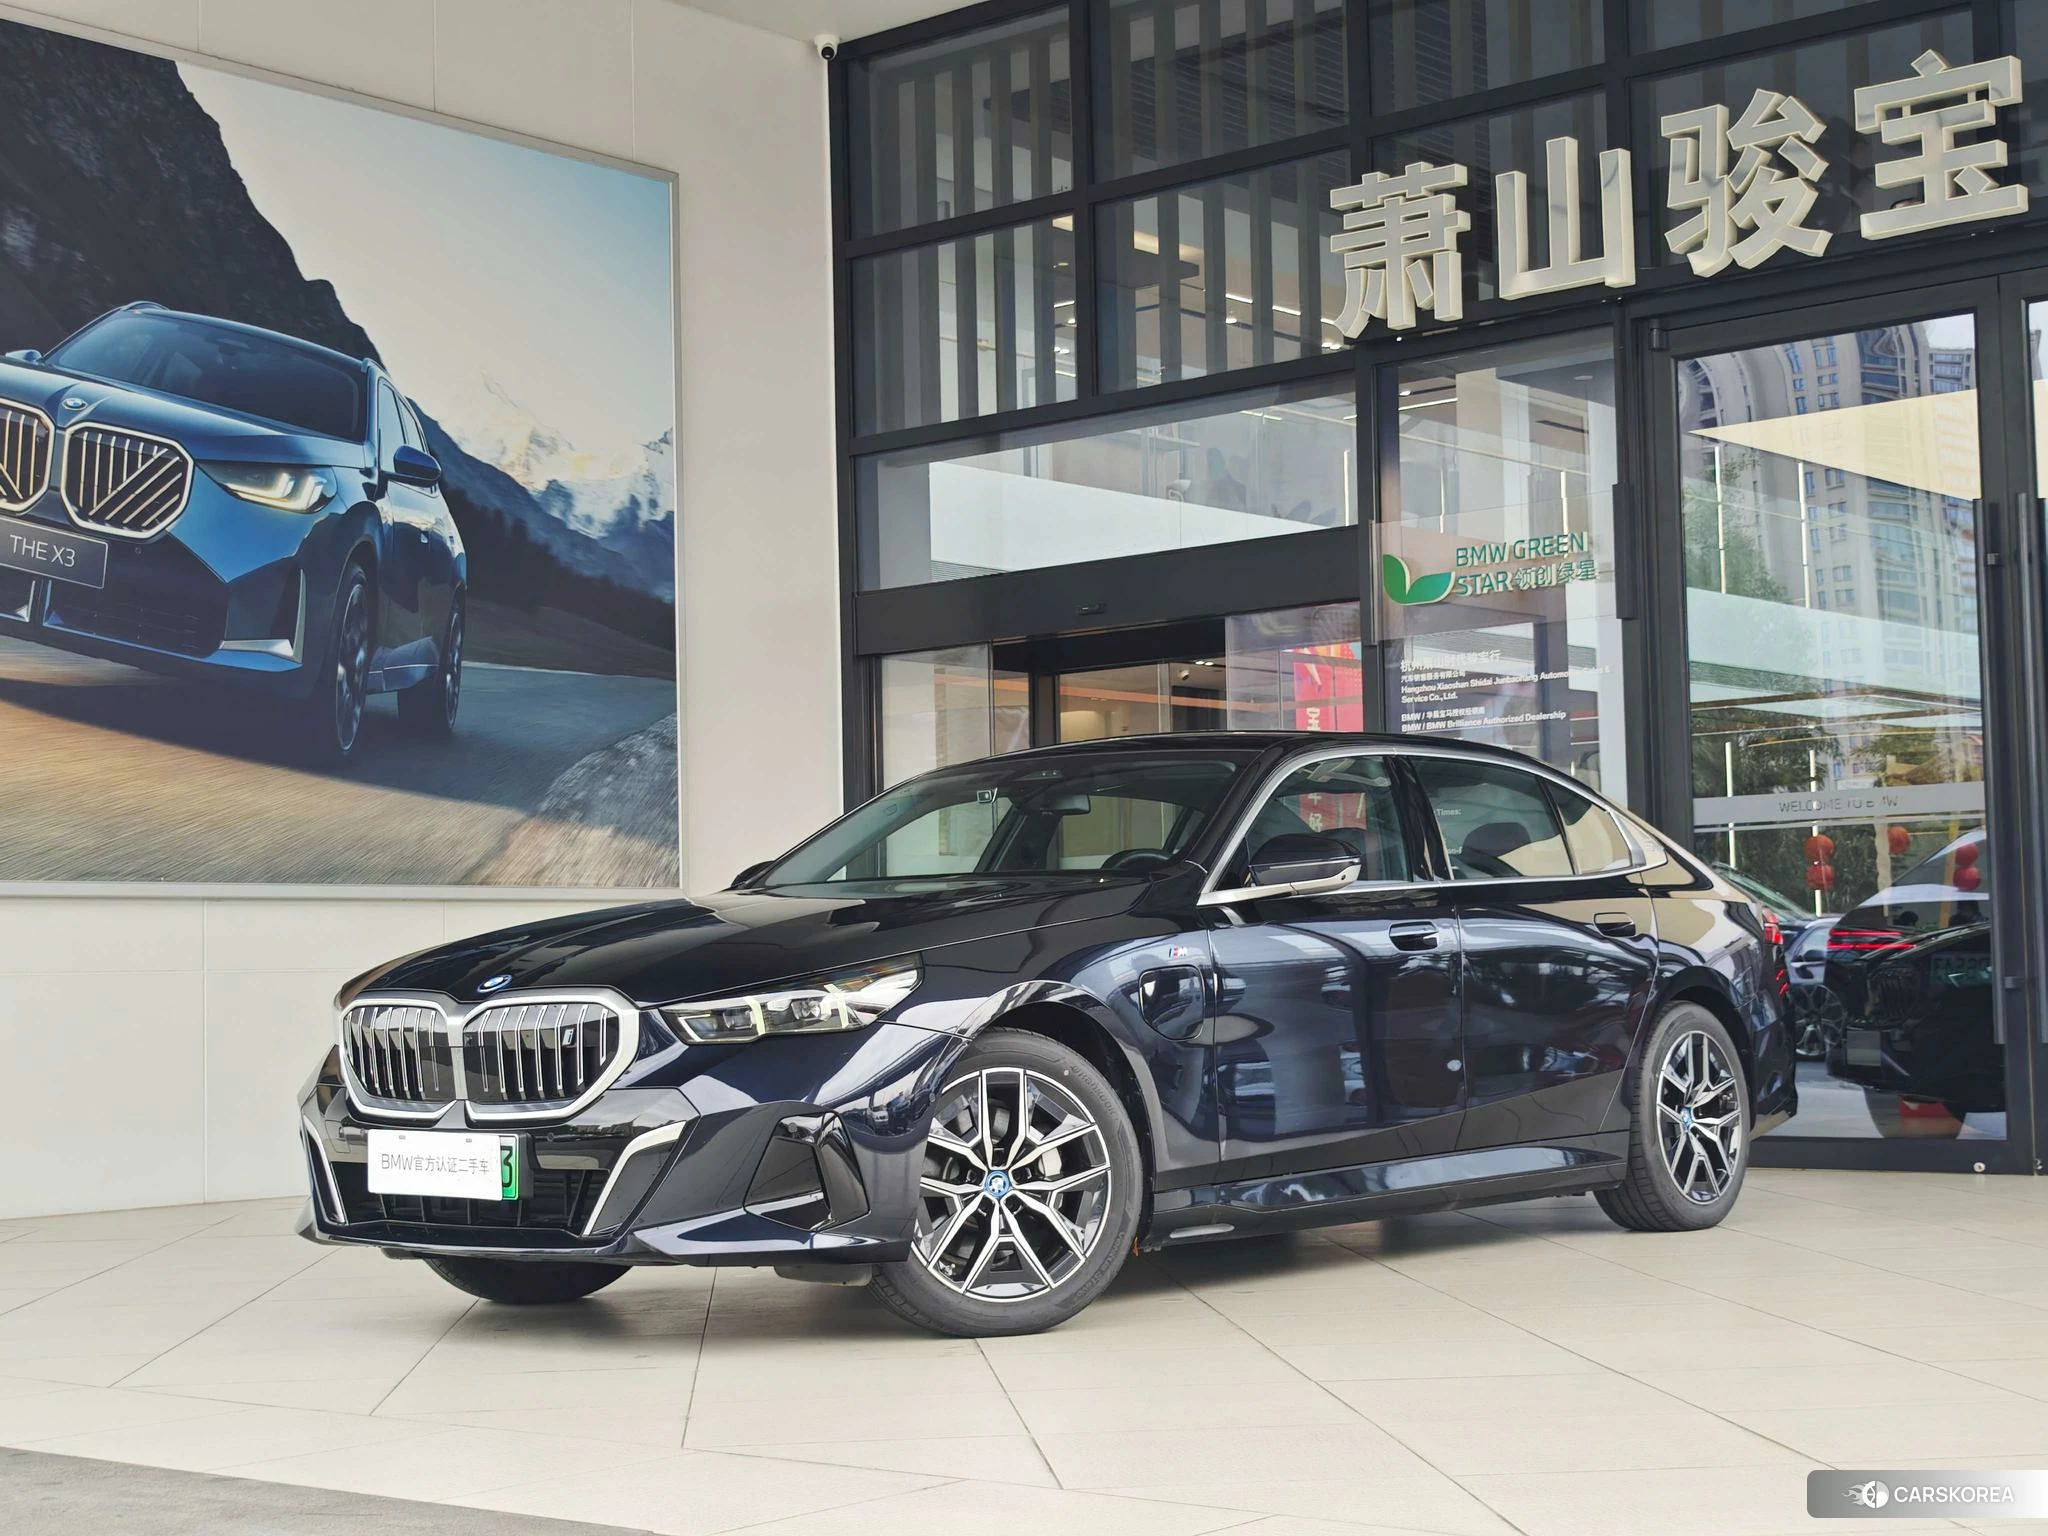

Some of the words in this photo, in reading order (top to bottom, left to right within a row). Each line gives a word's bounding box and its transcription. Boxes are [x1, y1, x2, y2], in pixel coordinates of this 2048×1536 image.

[1330, 49, 2029, 339] 萧山骏宝
[9, 534, 48, 561] THE
[51, 544, 76, 568] X3
[1456, 542, 1508, 567] BMW
[1513, 532, 1585, 560] GREEN
[1456, 571, 1510, 597] STAR
[1515, 560, 1597, 590] 领创绿星
[1401, 683, 1436, 694] Hangzhou
[1437, 680, 1469, 690] Xiaoshan
[1401, 694, 1428, 703] Service
[1401, 712, 1421, 721] BMW
[1401, 722, 1421, 733] BMW
[1426, 720, 1446, 730] BMW
[1447, 717, 1481, 728] Brilliance
[1483, 714, 1524, 725] Authorized
[1525, 710, 1566, 721] Dealership
[381, 1153, 490, 1175] BMW官方认证二手车
